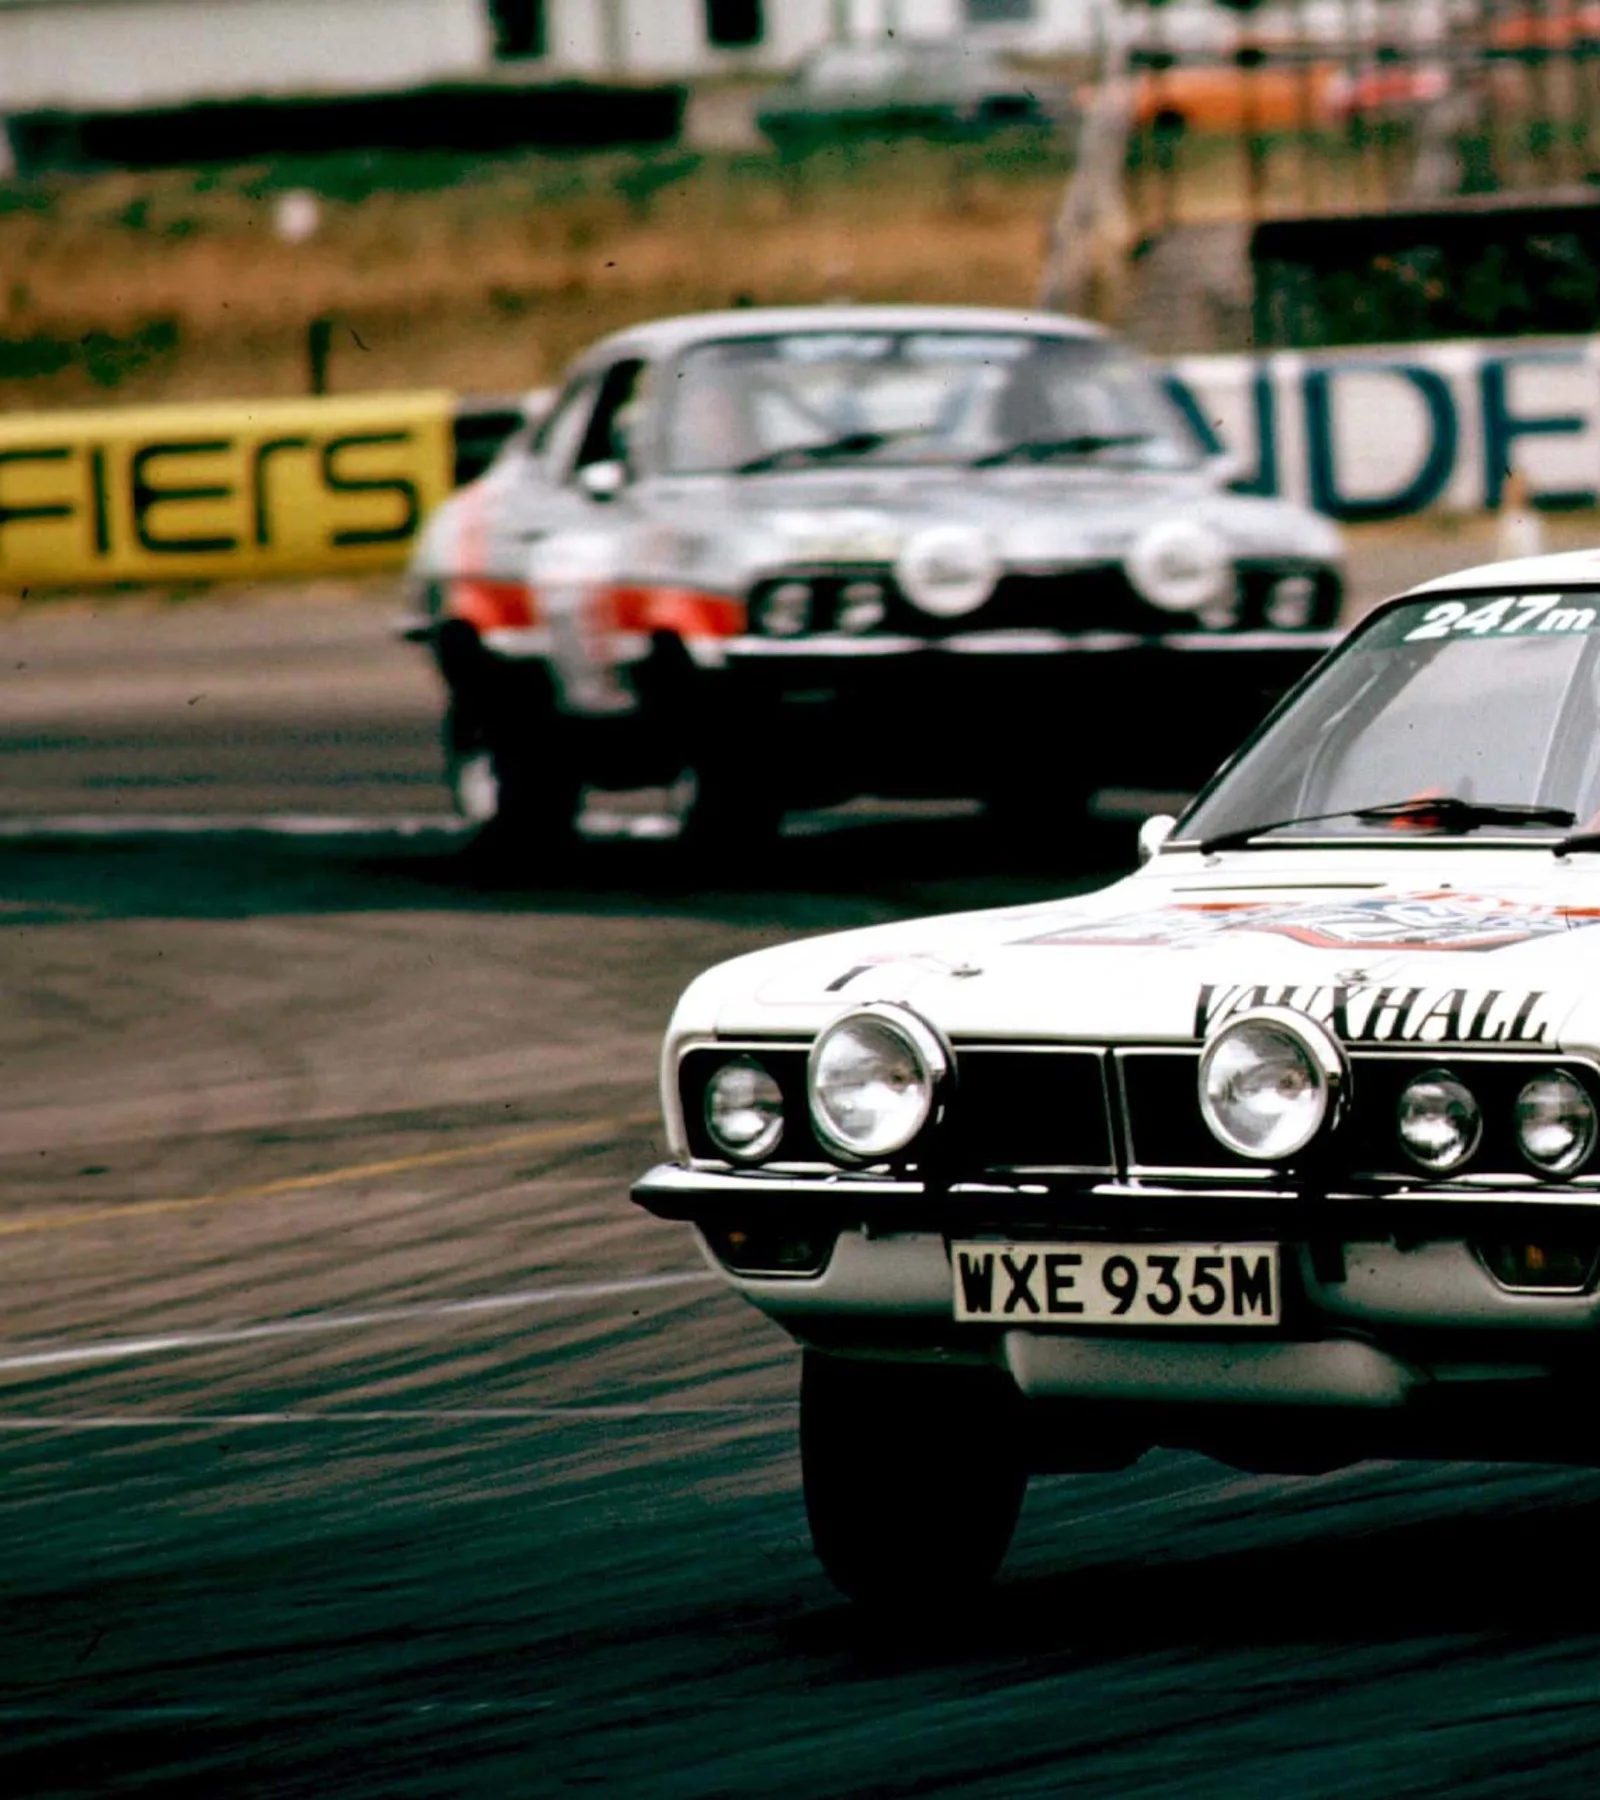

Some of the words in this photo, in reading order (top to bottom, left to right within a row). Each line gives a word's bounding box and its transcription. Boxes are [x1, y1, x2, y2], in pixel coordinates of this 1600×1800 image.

[1404, 594, 1596, 641] 247m
[958, 1253, 1084, 1314] WXE
[1101, 1254, 1273, 1317] 935M
